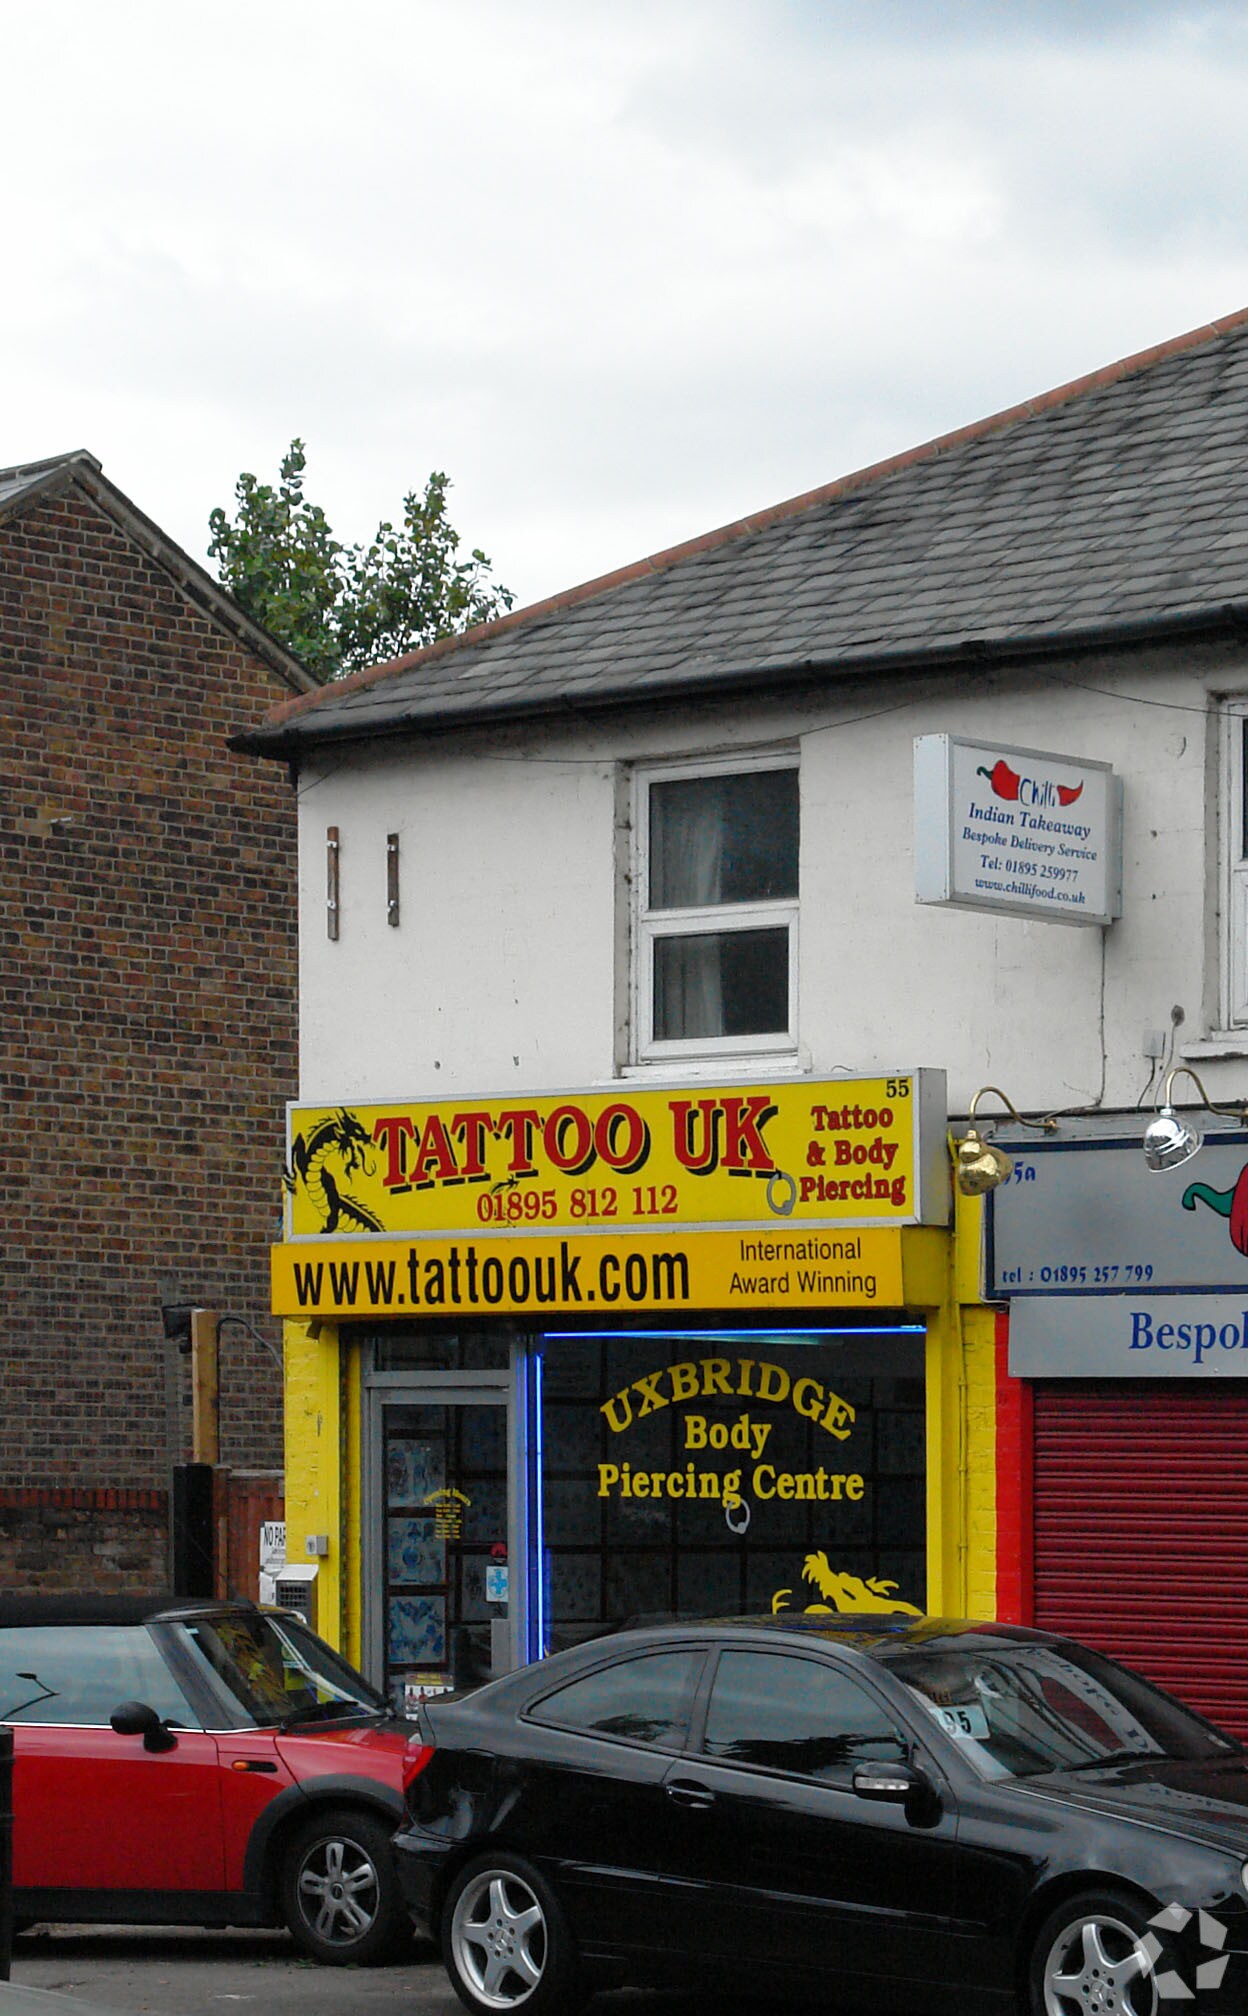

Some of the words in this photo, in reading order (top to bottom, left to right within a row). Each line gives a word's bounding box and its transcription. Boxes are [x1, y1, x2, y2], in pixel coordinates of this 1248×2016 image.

[1019, 778, 1056, 808] Chilli
[968, 802, 1015, 826] Indian
[1019, 810, 1091, 841] Takeaway
[962, 826, 1008, 847] Bespoke
[1010, 834, 1056, 857] Delivery
[1057, 842, 1098, 862] Service
[980, 854, 1003, 872] Tel:
[1005, 859, 1037, 877] 01895
[1040, 863, 1079, 883] 259977
[974, 877, 1086, 905] www.chillifood.co.uk
[886, 1079, 910, 1099] 55
[811, 1104, 894, 1132] Tattoo
[371, 1102, 651, 1195] TATTOO
[668, 1095, 778, 1178] UK
[806, 1140, 826, 1167] &
[834, 1136, 899, 1171] Body
[476, 1189, 558, 1223] 01895
[569, 1186, 618, 1218] 812
[632, 1185, 679, 1216] 112
[799, 1171, 907, 1207] Piercing
[740, 1237, 862, 1262] International
[293, 1240, 690, 1306] www.tattoouk.com
[729, 1271, 790, 1295] Award
[797, 1269, 877, 1299] Winning
[1040, 1265, 1087, 1284] 01895
[1093, 1264, 1119, 1284] 257
[1124, 1263, 1154, 1283] 799
[599, 1357, 857, 1441] UXBRIDGE
[684, 1412, 772, 1460] Body
[597, 1461, 742, 1509] Piercing
[752, 1463, 865, 1501] Centre
